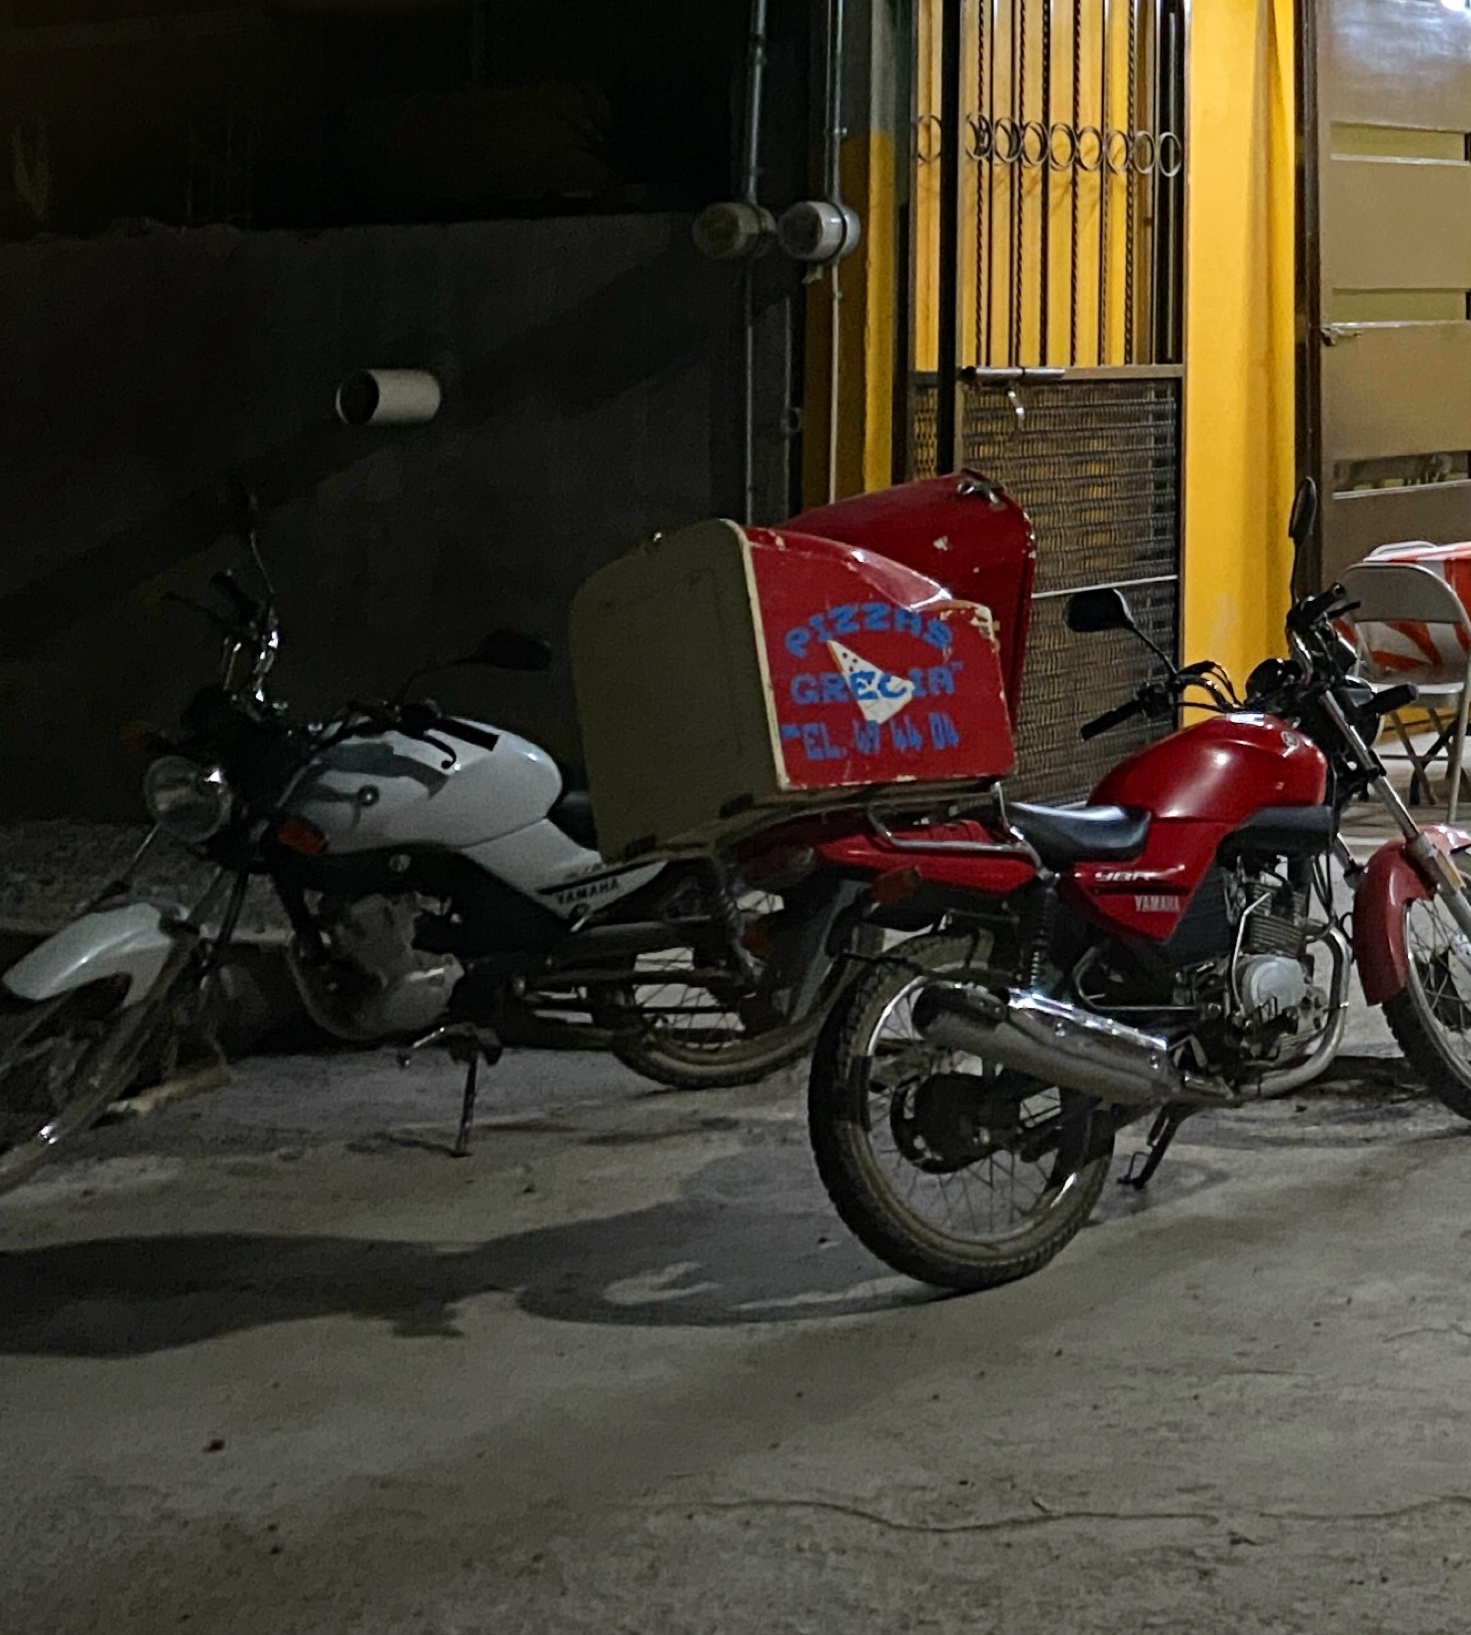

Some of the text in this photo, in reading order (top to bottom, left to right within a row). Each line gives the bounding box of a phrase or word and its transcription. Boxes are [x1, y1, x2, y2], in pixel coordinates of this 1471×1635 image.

[785, 602, 953, 659] PIZZAS
[555, 876, 619, 905] YAMAHA
[1134, 895, 1179, 913] YAMAHA
